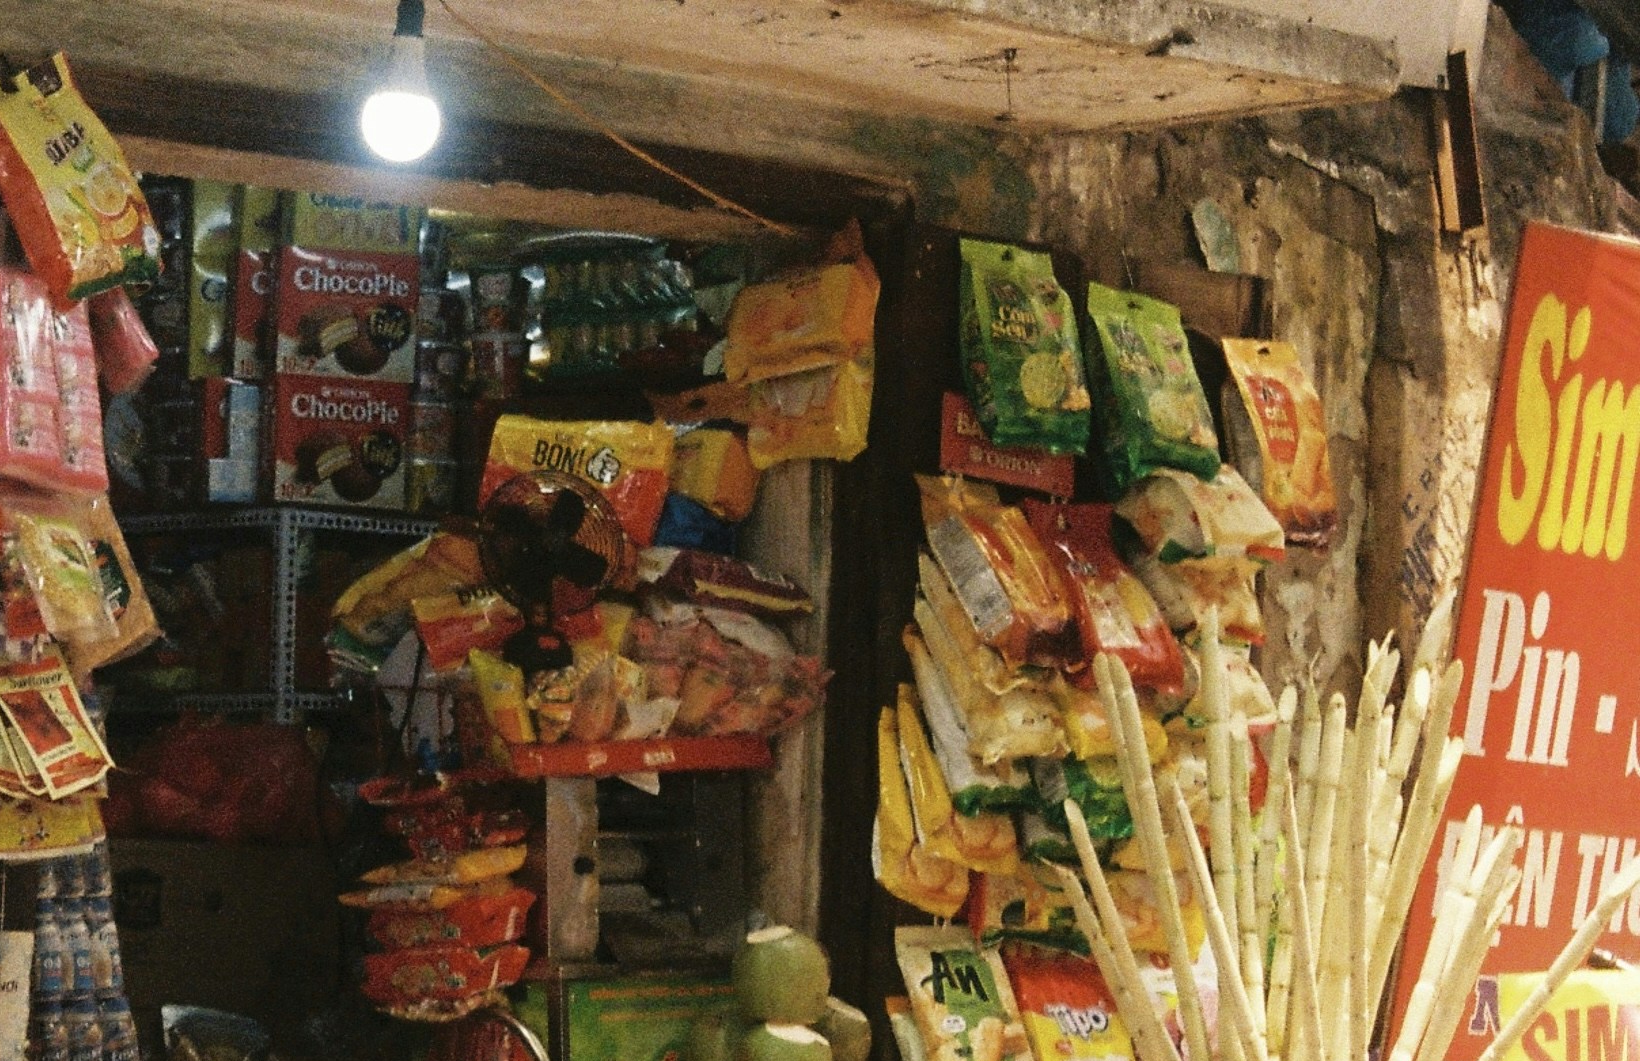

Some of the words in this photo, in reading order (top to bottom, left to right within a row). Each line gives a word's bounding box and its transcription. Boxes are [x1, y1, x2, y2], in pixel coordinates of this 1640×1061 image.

[293, 266, 409, 297] ChocoPie
[291, 393, 400, 424] ChocoPie
[1498, 293, 1640, 562] Sim
[1464, 588, 1581, 768] Pin
[920, 951, 990, 1004] An
